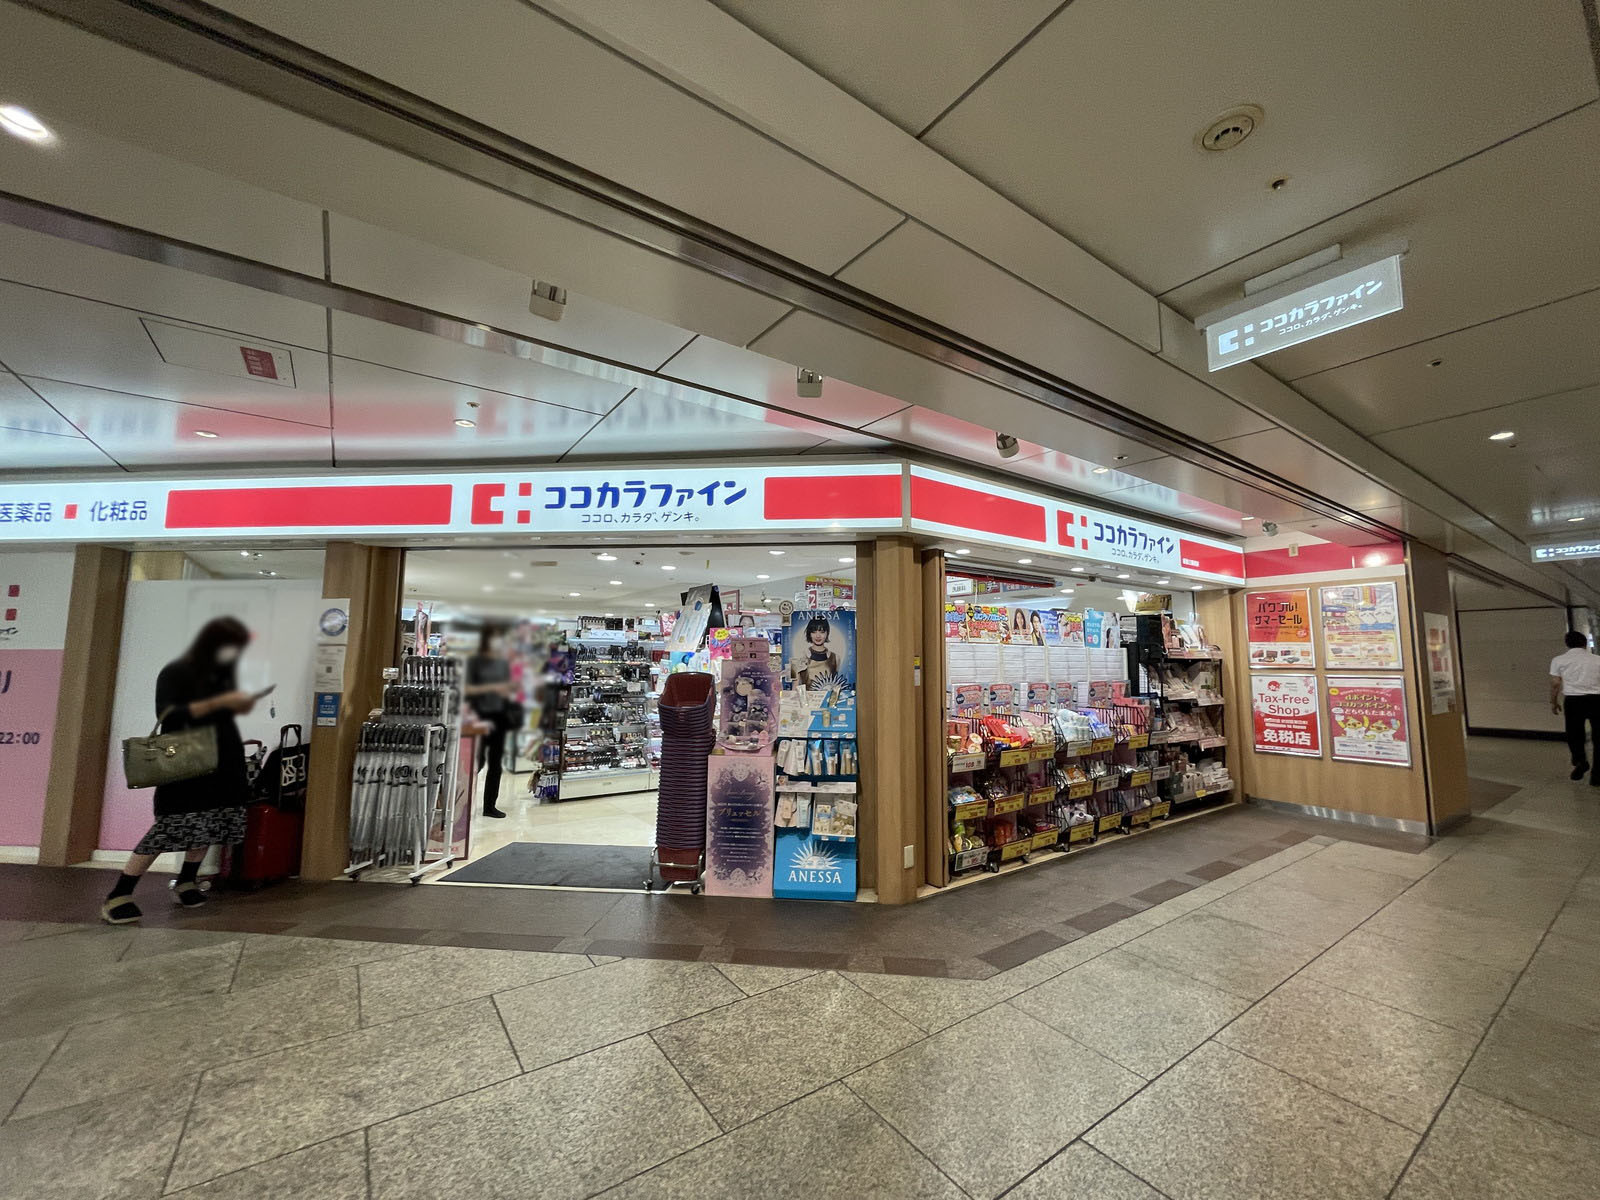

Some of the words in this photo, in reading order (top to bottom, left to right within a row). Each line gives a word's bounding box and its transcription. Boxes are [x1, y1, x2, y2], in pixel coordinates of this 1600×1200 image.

[1260, 280, 1382, 333] ココカラファイン
[544, 480, 747, 509] ココカラファイン
[0, 502, 52, 522] 医薬品
[90, 500, 147, 521] 化粧品
[581, 512, 700, 523] ココロ、カラダ、ゲンキ。
[1094, 522, 1174, 554] ココカラファイン
[798, 611, 840, 620] ANESSA
[1255, 615, 1303, 625] サマーセール
[1258, 693, 1310, 704] Tax-Free
[1268, 704, 1300, 717] Shop
[1263, 729, 1311, 745] 免税店
[788, 870, 842, 884] ANESSA
